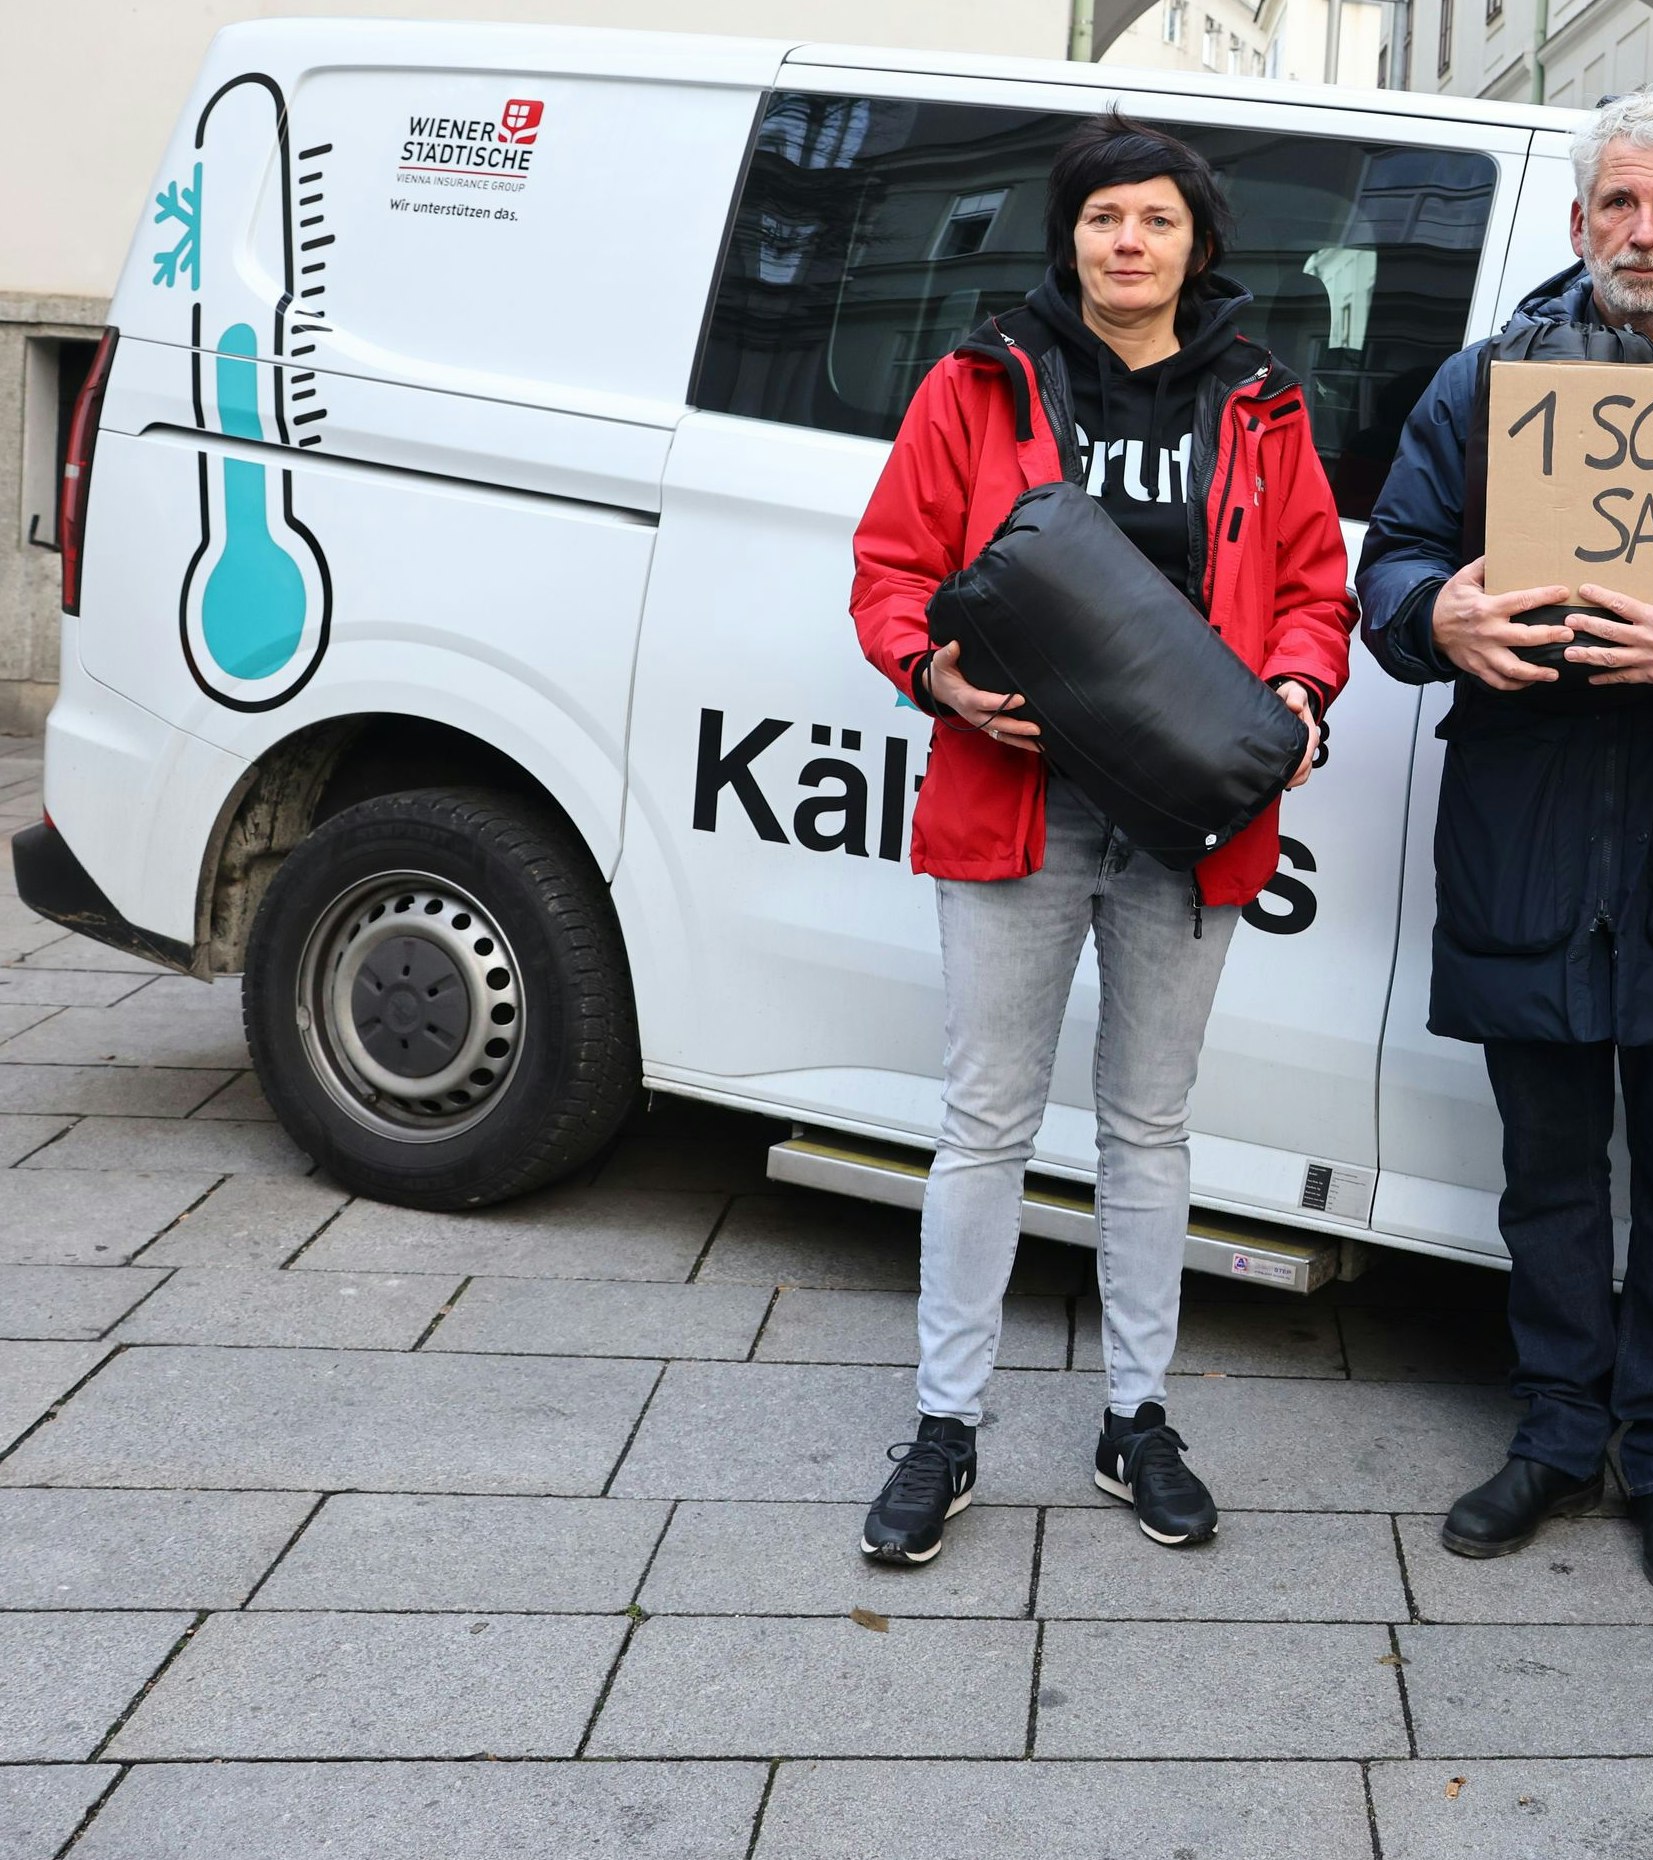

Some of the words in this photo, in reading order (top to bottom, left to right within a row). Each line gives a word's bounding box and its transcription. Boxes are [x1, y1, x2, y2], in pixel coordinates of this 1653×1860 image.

[409, 116, 495, 142] WIENER
[401, 141, 533, 170] STÄDTISCHE
[396, 173, 431, 185] VIENNA
[433, 175, 489, 190] INSURANCE
[491, 181, 525, 192] GROUP
[389, 198, 411, 211] Wir
[413, 201, 491, 219] unterstützen
[494, 207, 518, 221] das.
[1508, 390, 1556, 476] 1
